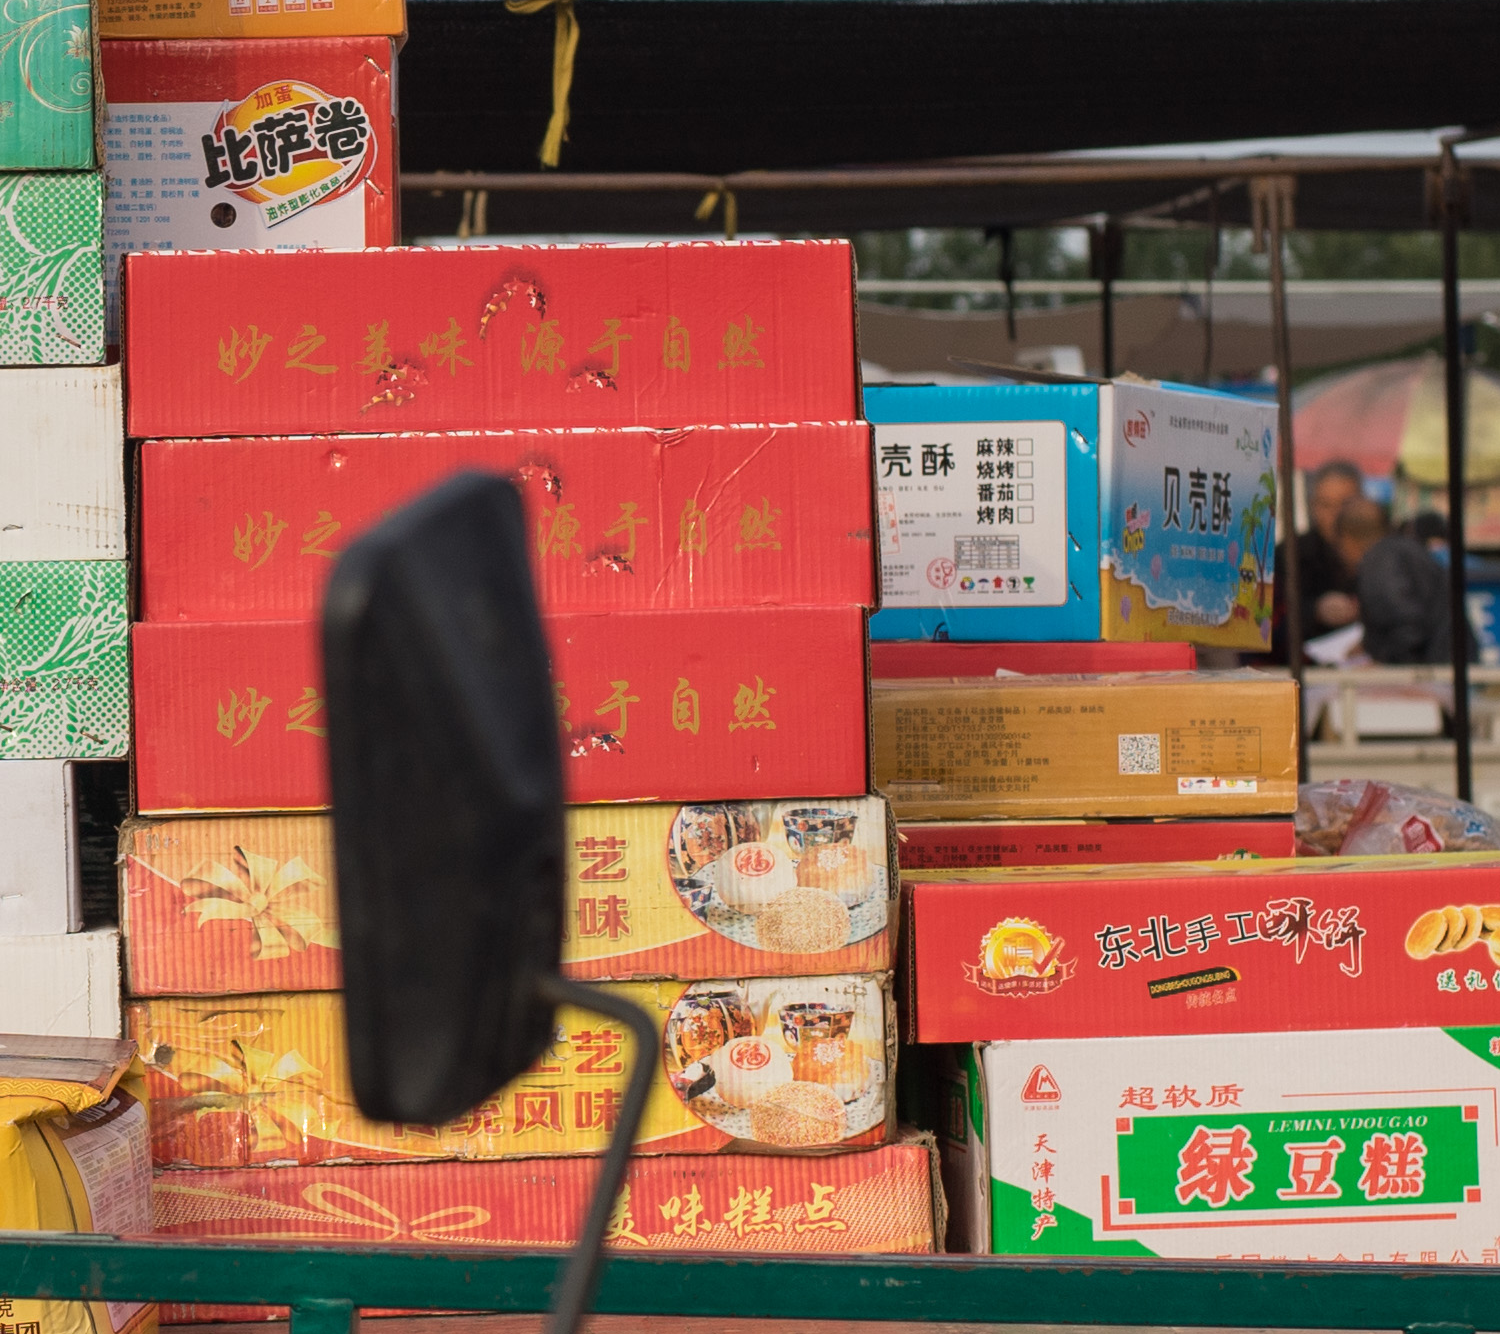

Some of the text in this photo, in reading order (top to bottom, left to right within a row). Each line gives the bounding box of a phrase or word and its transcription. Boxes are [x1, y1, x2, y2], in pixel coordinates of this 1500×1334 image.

[255, 85, 293, 109] 加蛋
[202, 100, 368, 188] 比萨卷
[218, 315, 766, 384] 妙之美味 源于自然
[879, 443, 956, 477] 壳酥
[977, 439, 1014, 456] 麻辣
[977, 461, 1014, 480] 烧烤
[977, 483, 1014, 502] 番茄
[977, 505, 1014, 524] 烤肉
[1163, 466, 1232, 535] 贝壳酥
[537, 497, 783, 560] 源于自然
[561, 676, 778, 738] 于自然
[1096, 899, 1366, 977] 东北手工酥饼
[1119, 1084, 1244, 1109] 超软质
[1031, 1133, 1057, 1240] 天津特产
[1176, 1126, 1427, 1206] 绿豆糕
